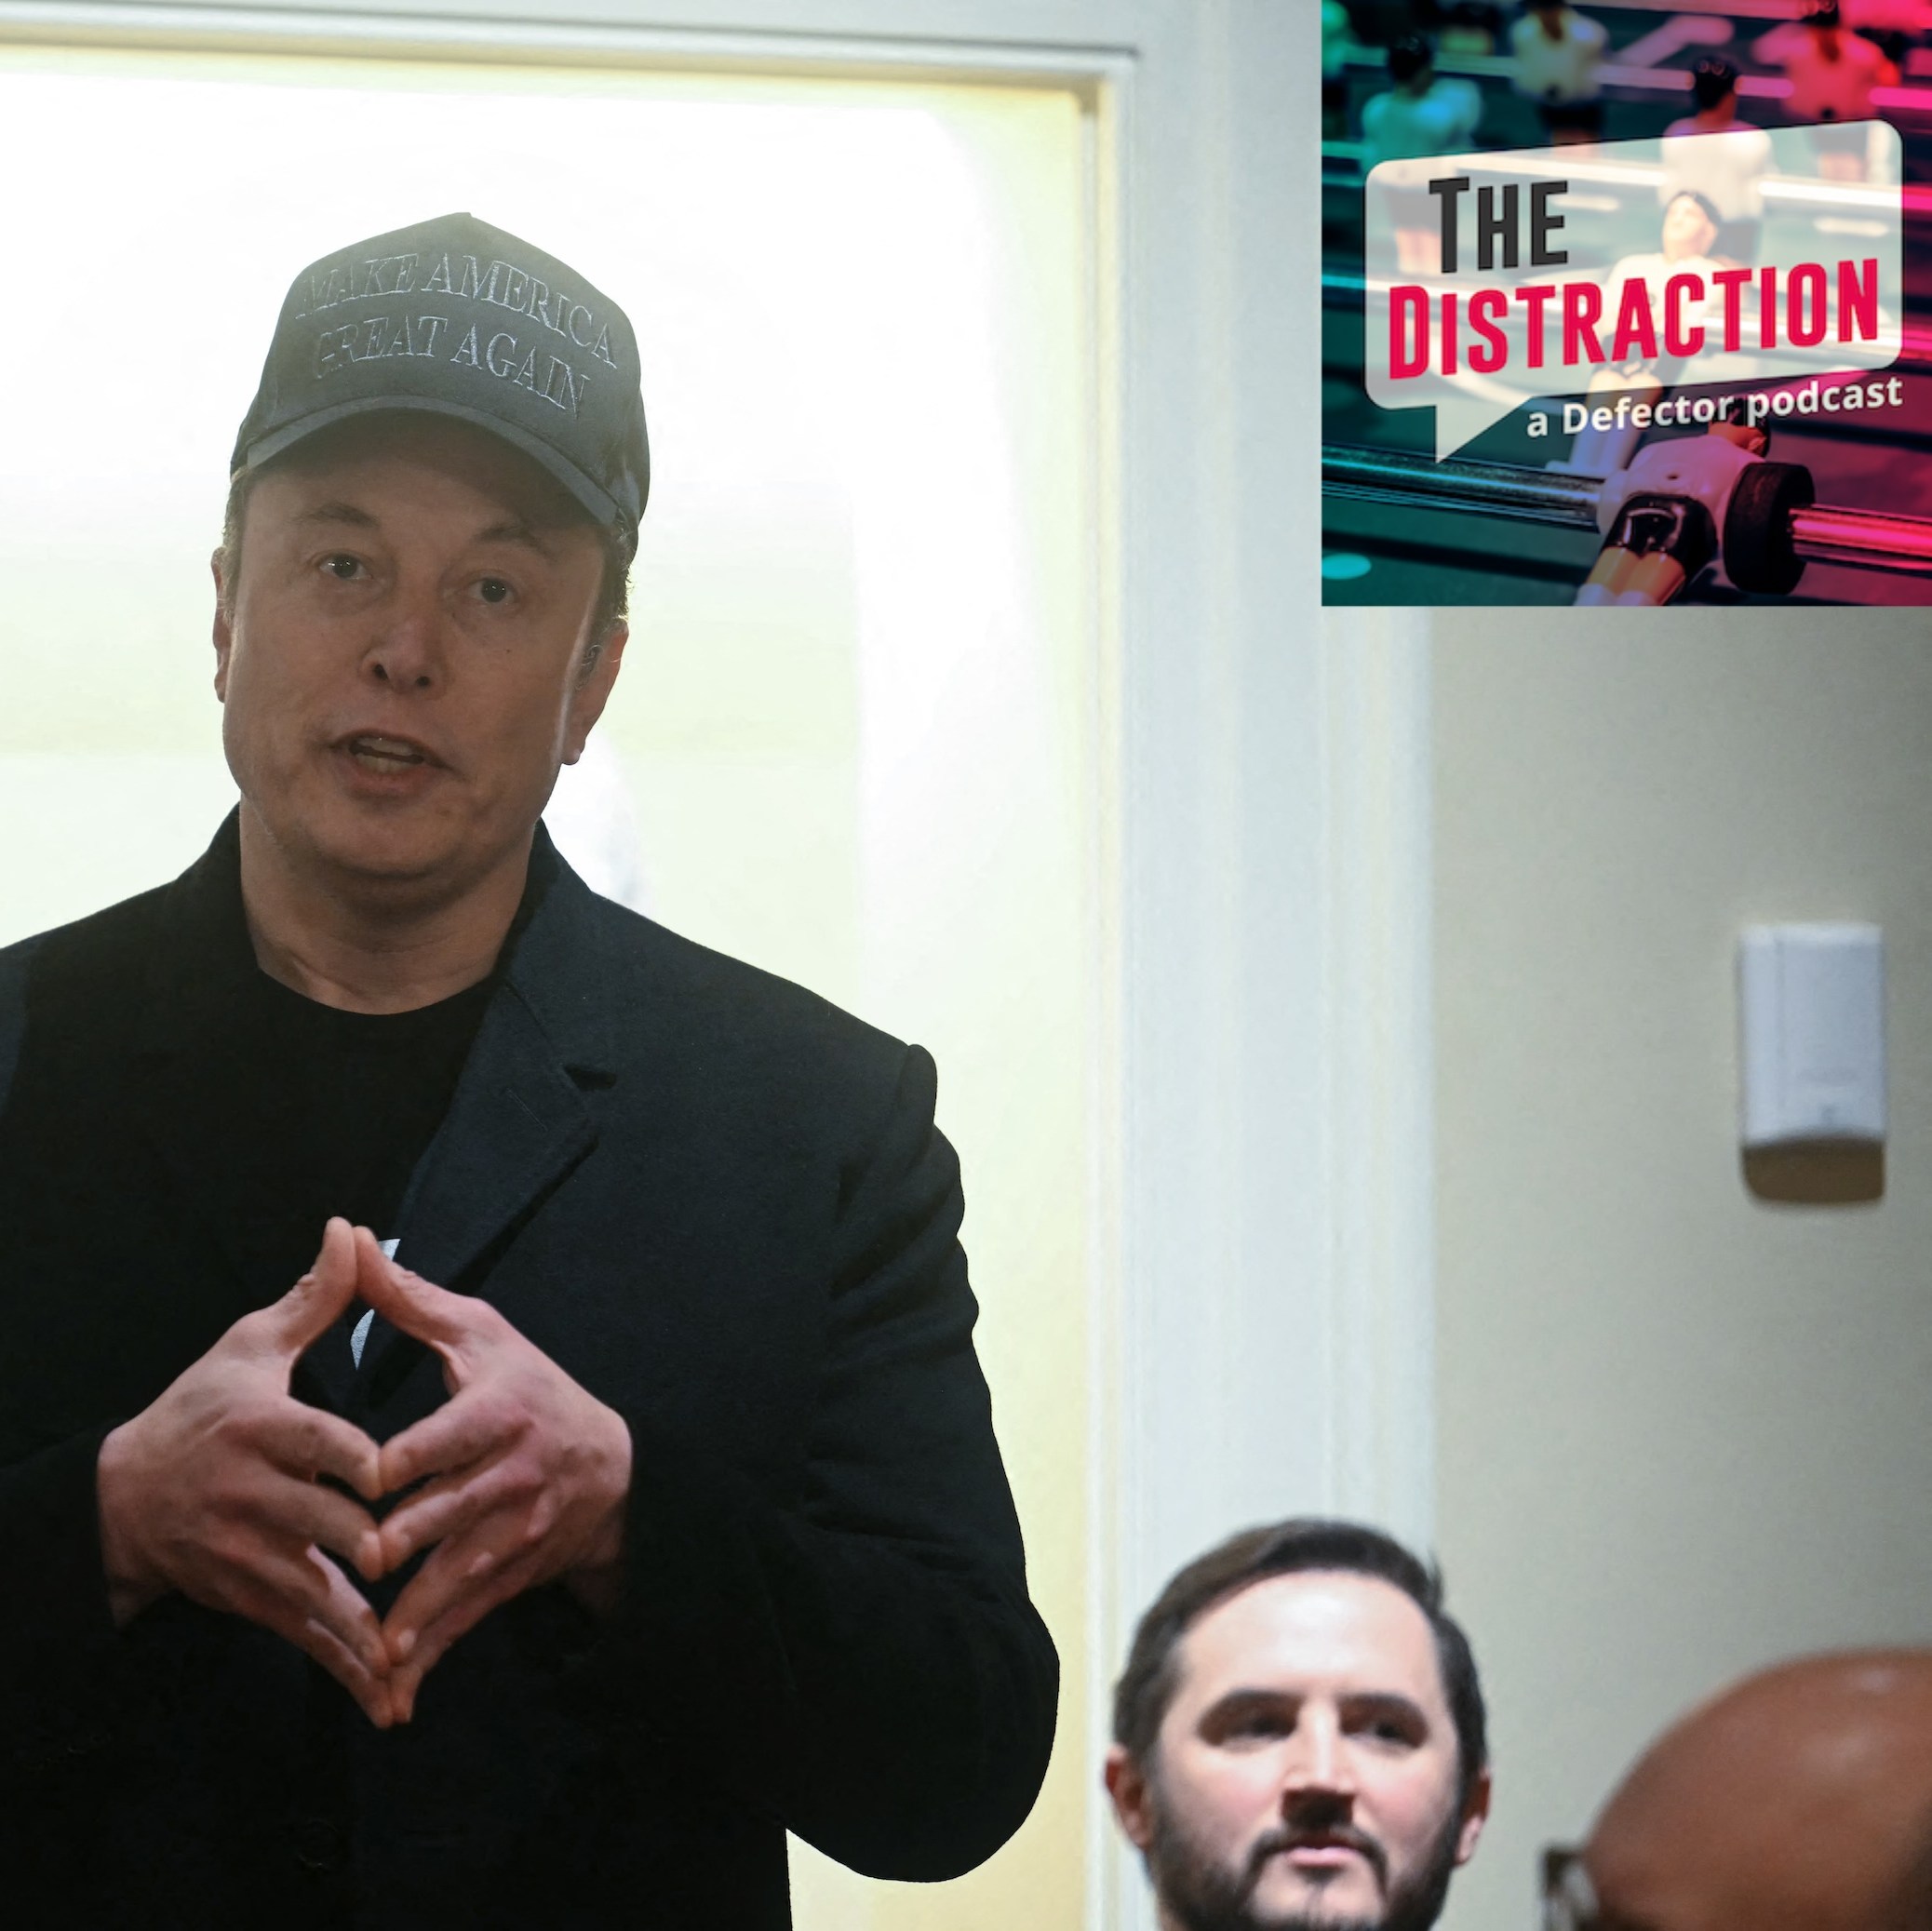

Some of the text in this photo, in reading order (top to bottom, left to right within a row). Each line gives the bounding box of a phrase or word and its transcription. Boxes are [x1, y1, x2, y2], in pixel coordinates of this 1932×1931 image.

[295, 252, 618, 369] MAKE AMERICA
[315, 315, 591, 420] GREAT AGAIN
